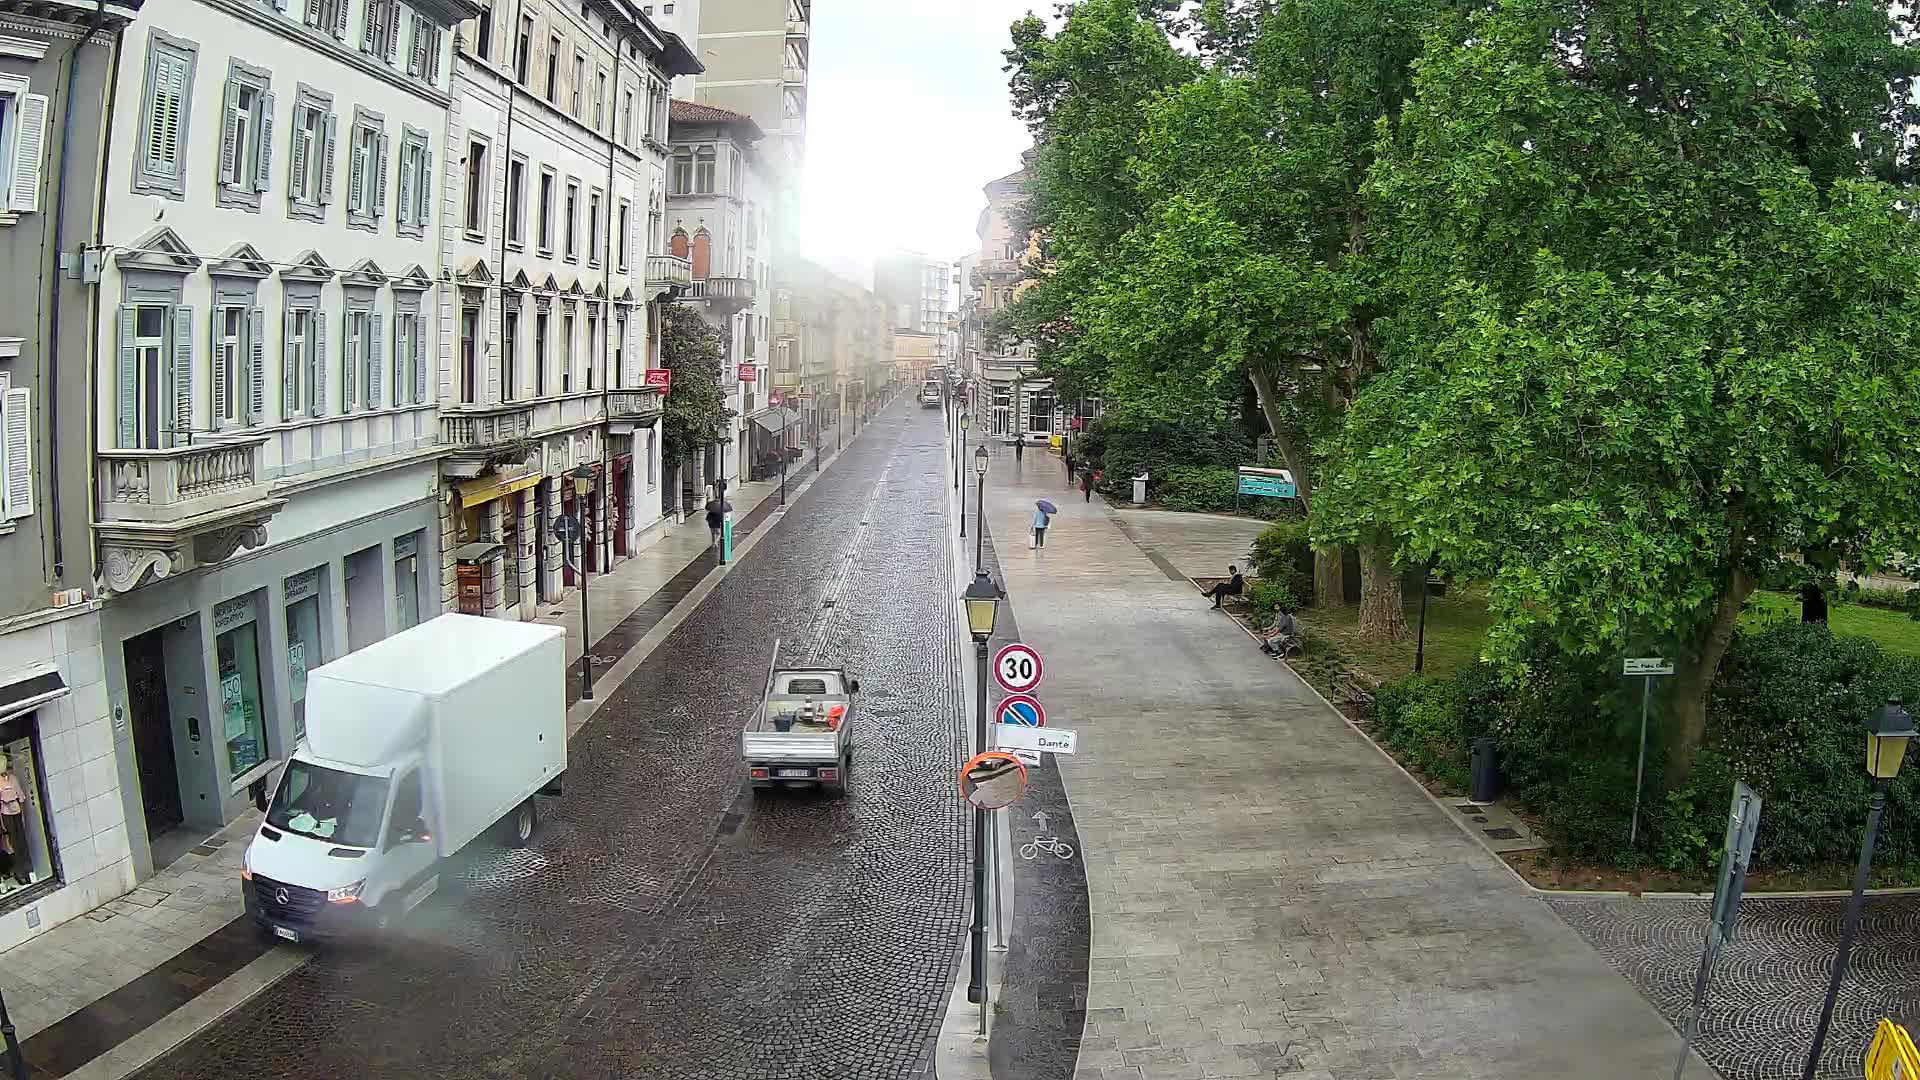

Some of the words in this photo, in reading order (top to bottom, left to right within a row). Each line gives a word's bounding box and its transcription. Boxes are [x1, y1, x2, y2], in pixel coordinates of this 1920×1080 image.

[1005, 658, 1032, 680] 30
[222, 677, 240, 700] 130
[1038, 738, 1070, 748] Dante
